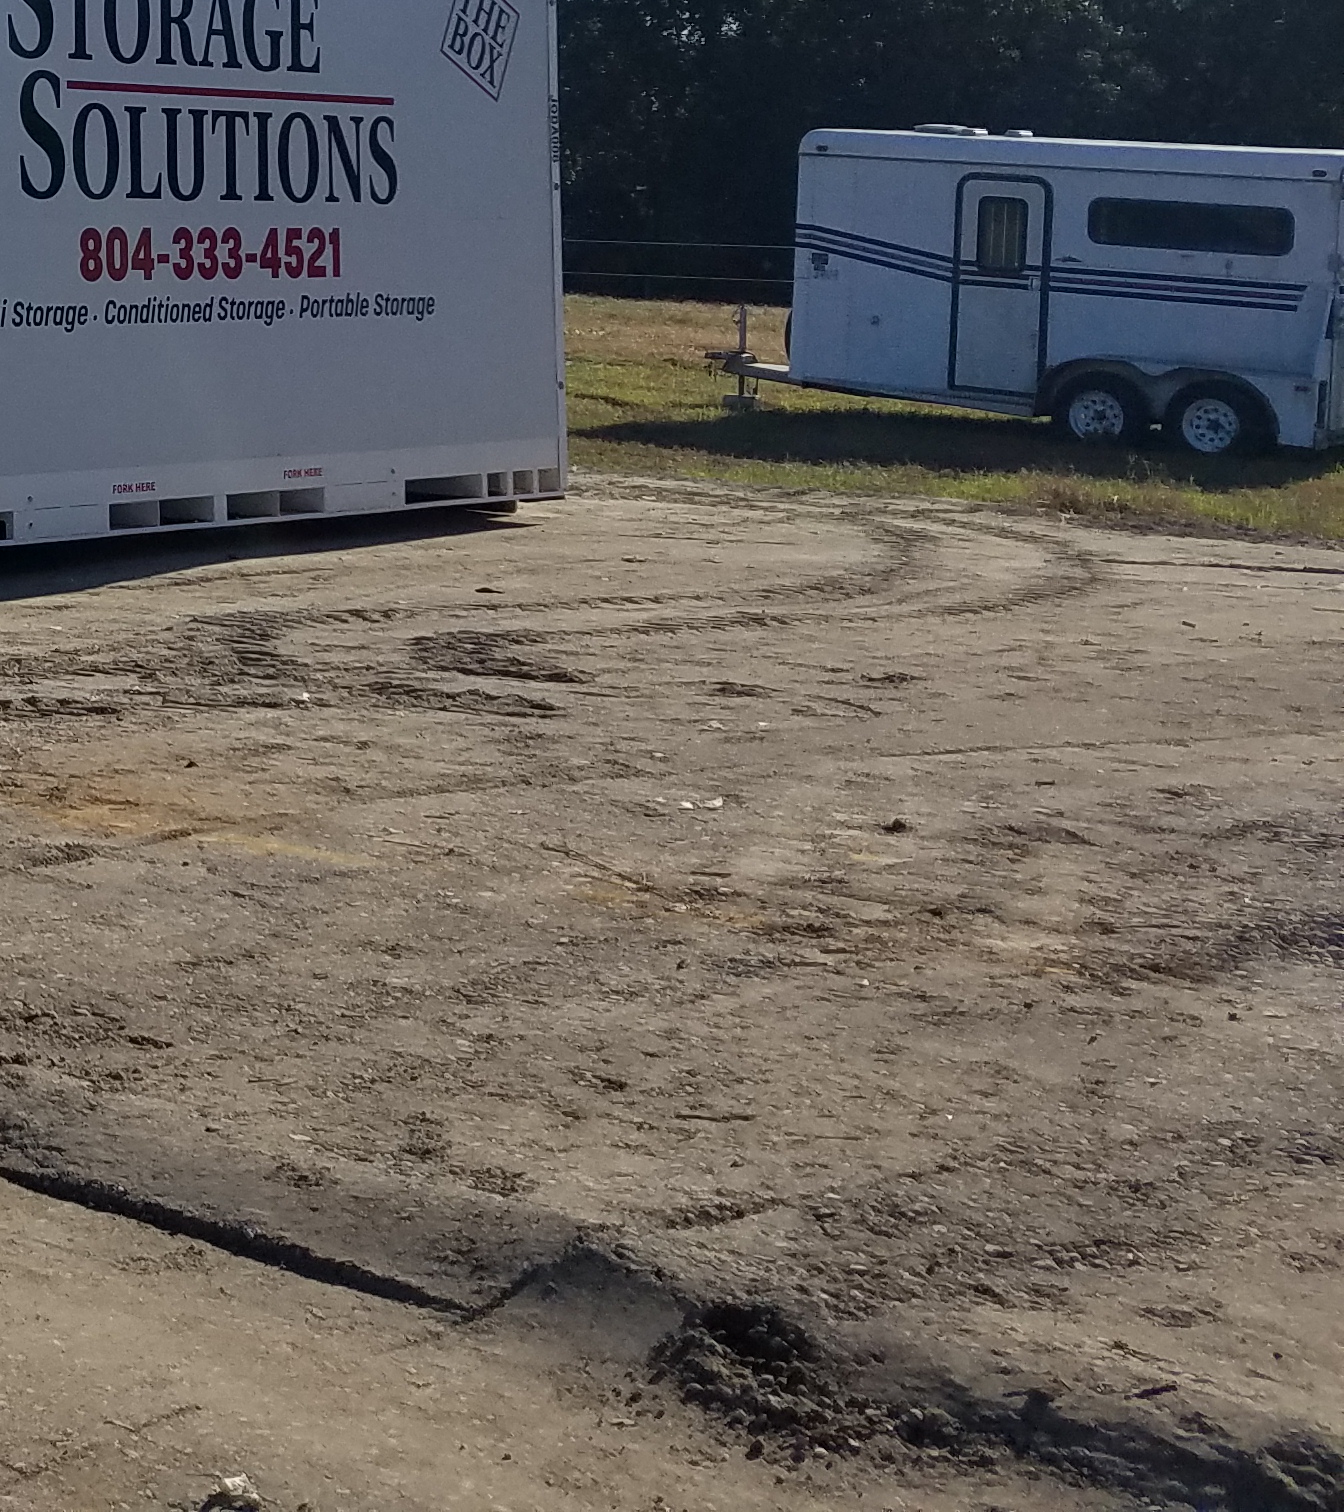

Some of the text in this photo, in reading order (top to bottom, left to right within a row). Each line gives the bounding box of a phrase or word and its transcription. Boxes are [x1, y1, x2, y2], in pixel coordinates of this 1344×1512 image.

[448, 12, 503, 89] BOX
[19, 69, 399, 205] SOLUTIONS
[79, 226, 342, 282] 804-333-4521
[11, 300, 89, 333] Storage
[104, 295, 215, 325] Conditioned
[216, 296, 286, 327] Storage
[299, 291, 370, 319] Portable
[373, 292, 436, 322] Storage
[112, 481, 156, 495] FORK HERE
[283, 467, 323, 480] FORK HERE
